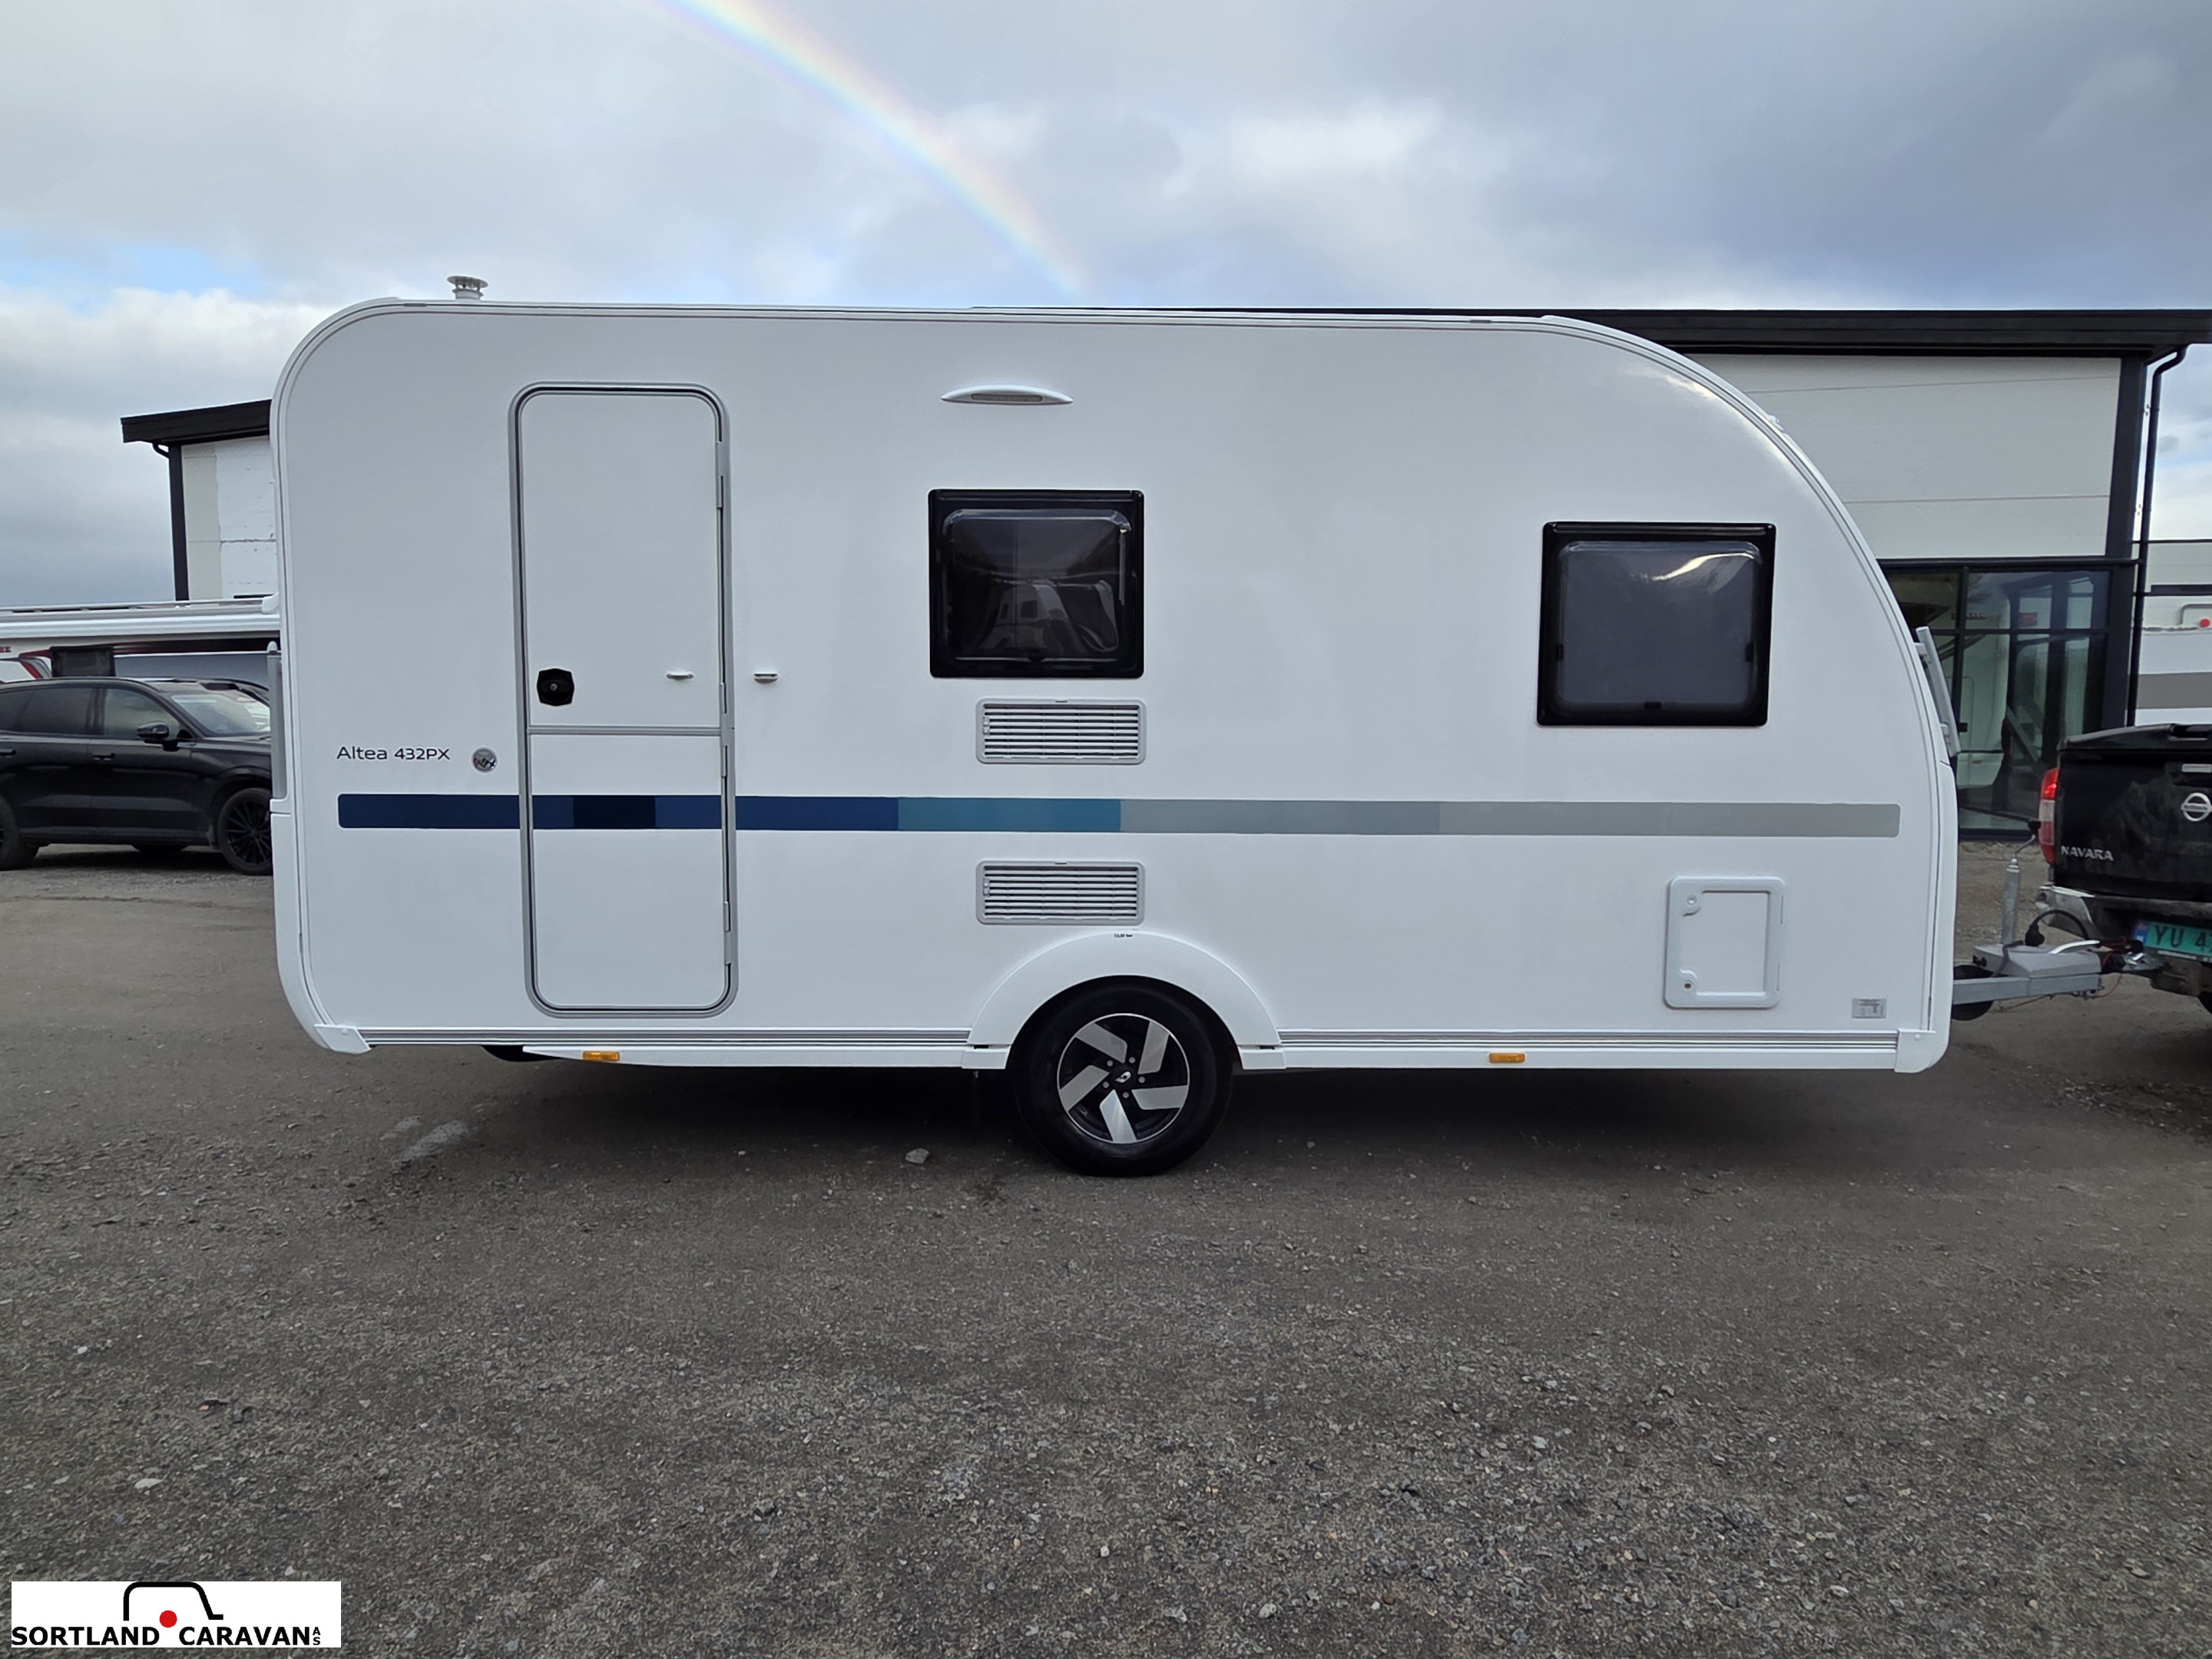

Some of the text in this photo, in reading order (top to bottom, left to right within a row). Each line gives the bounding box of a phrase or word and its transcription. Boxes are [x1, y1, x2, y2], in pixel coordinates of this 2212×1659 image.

[336, 746, 451, 760] Altea 432PX
[2061, 846, 2114, 861] NAVARA
[2154, 924, 2212, 953] YU 4
